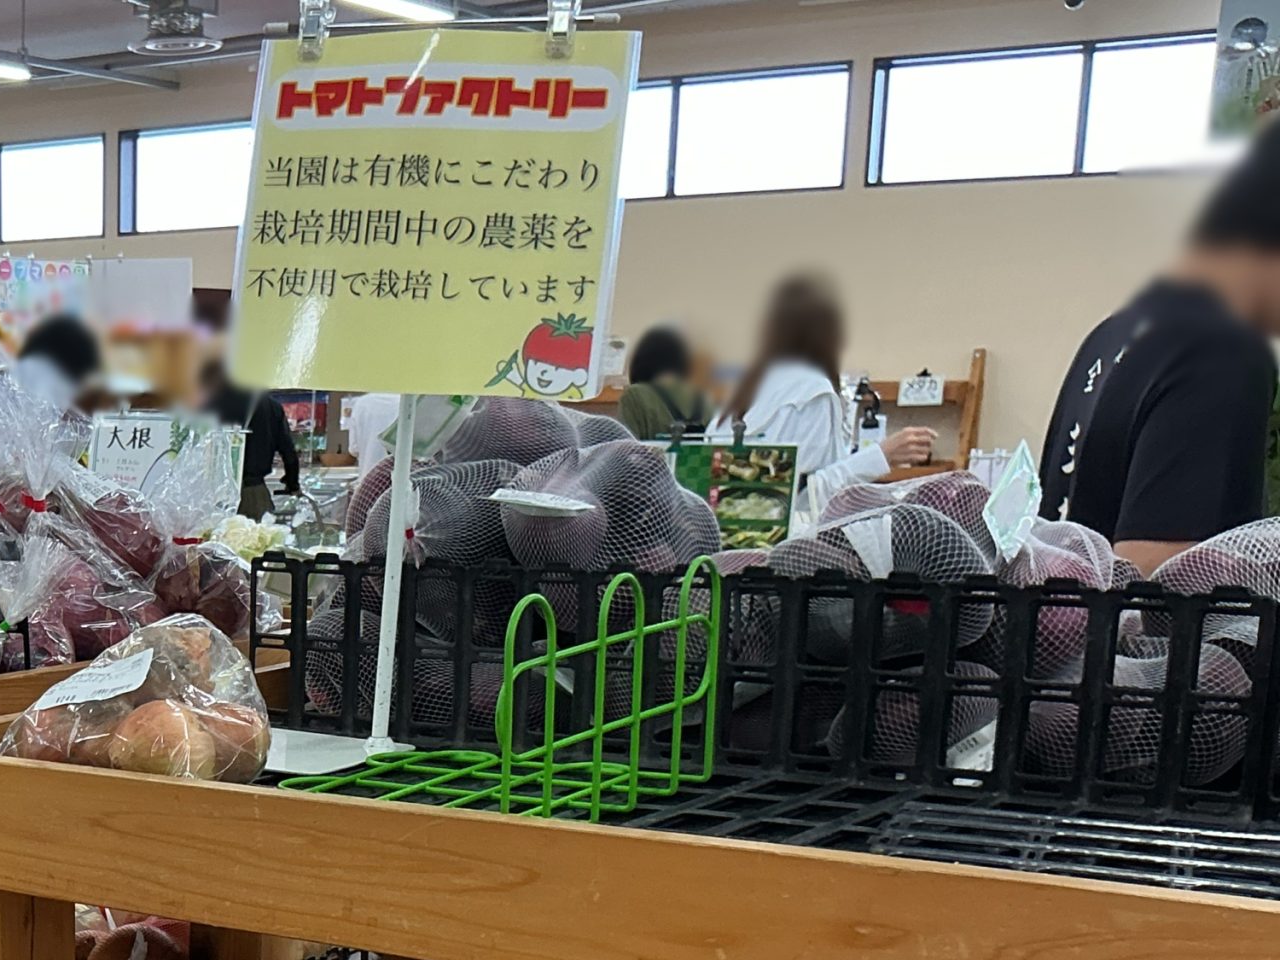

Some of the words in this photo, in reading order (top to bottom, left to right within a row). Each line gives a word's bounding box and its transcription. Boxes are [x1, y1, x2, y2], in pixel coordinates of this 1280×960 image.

[276, 77, 609, 120] トマトファクトリー
[263, 154, 601, 193] 当園は有機にこだわり
[253, 210, 594, 250] 栽培期間中の農薬を
[247, 269, 596, 305] 不使用で栽培しています
[106, 426, 154, 450] 大根
